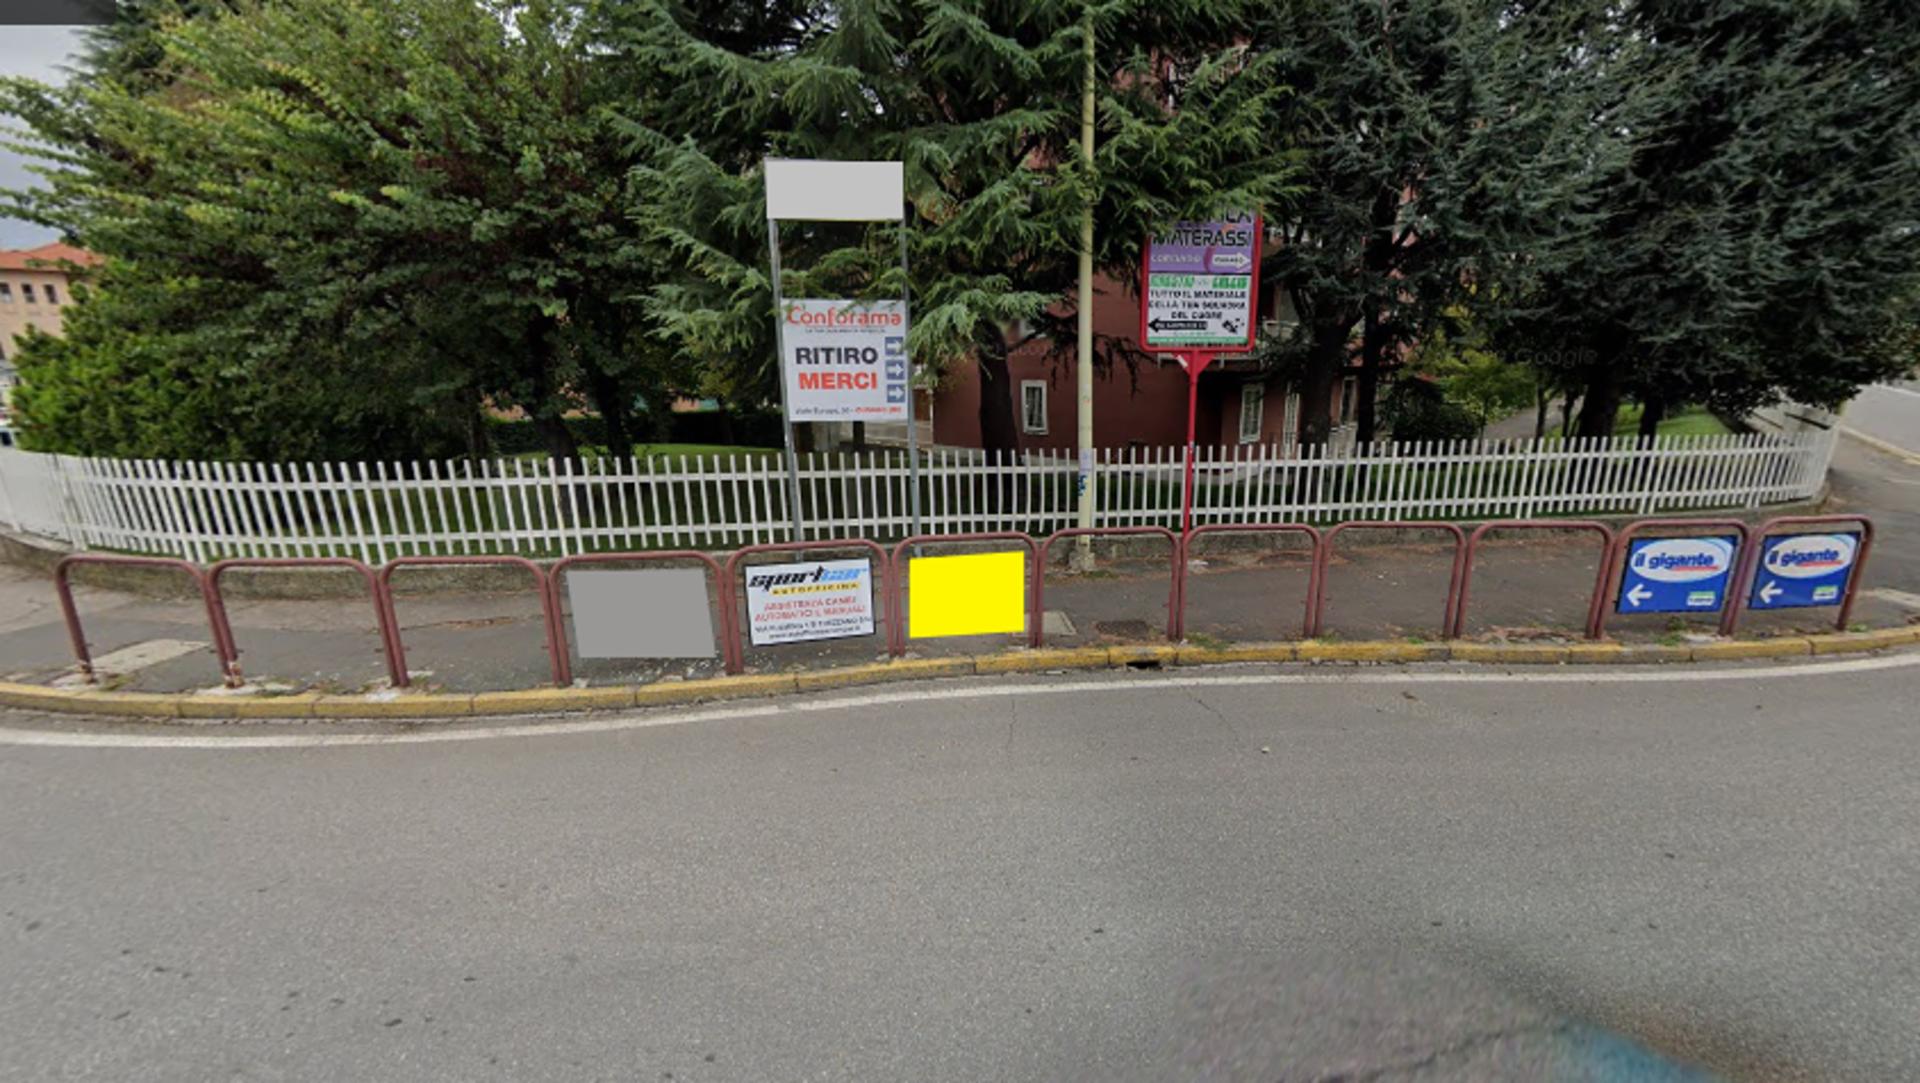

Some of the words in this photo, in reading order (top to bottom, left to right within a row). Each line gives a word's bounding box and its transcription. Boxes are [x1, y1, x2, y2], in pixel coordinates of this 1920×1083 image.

[1194, 291, 1246, 299] MATERIALE
[787, 306, 902, 328] Conforama
[795, 347, 878, 365] RITIRO
[799, 372, 877, 390] MERCI
[1634, 553, 1646, 567] il
[1649, 552, 1715, 570] gigante
[1768, 550, 1779, 565] il
[1781, 549, 1839, 567] gigante
